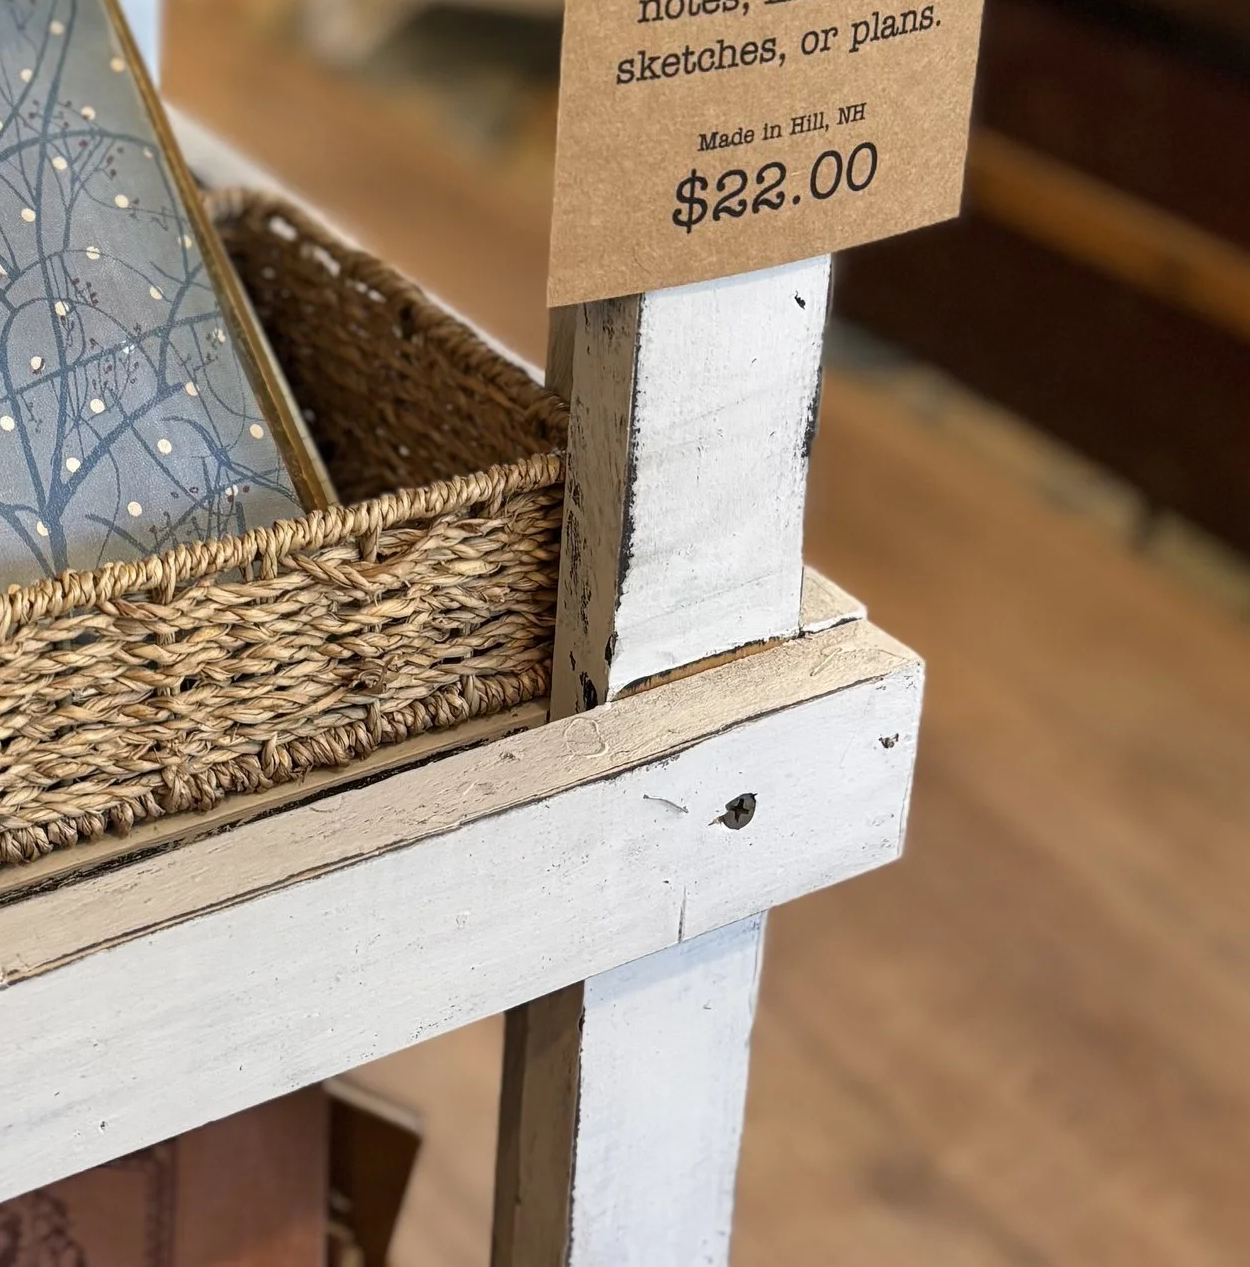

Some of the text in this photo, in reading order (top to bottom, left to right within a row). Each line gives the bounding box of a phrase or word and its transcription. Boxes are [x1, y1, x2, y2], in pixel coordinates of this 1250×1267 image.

[615, 4, 942, 85] sketches, or plans.
[697, 103, 867, 152] Made in Hill, NH
[671, 142, 878, 233] $22.00
